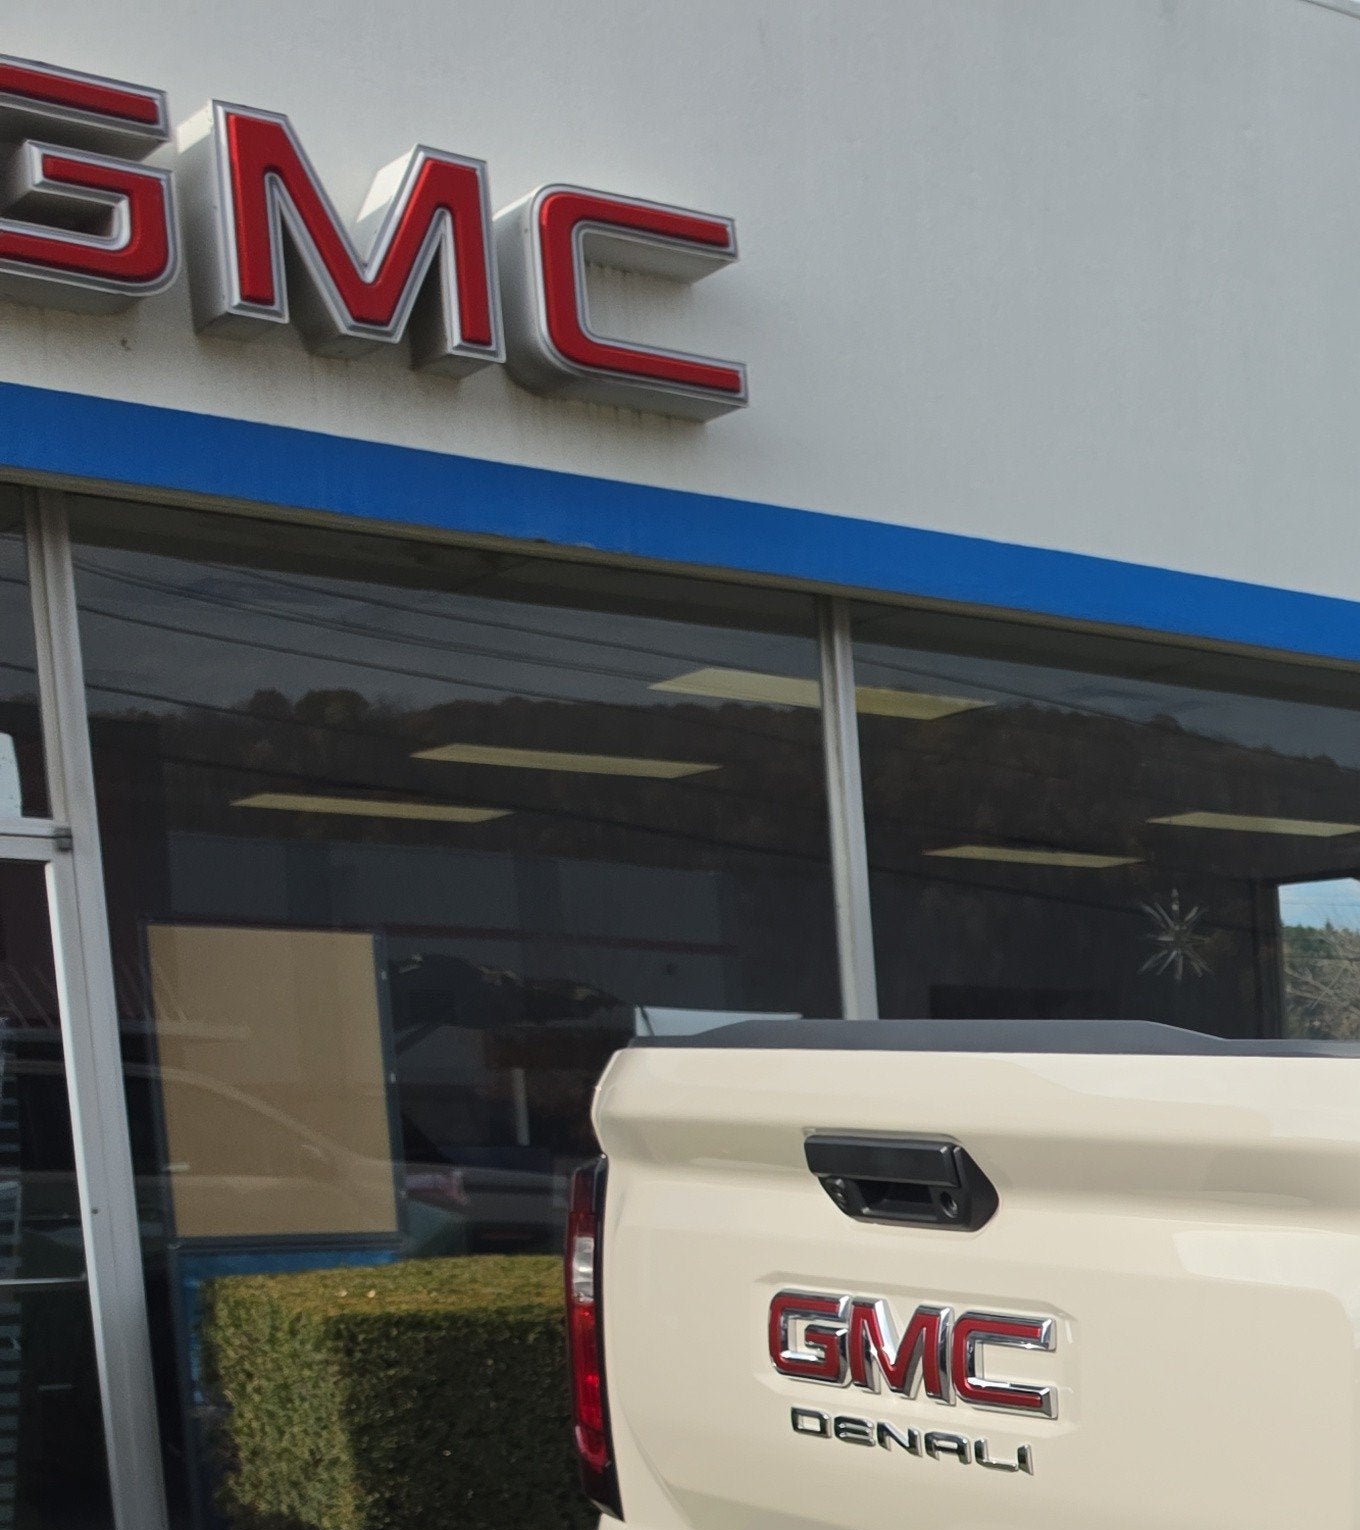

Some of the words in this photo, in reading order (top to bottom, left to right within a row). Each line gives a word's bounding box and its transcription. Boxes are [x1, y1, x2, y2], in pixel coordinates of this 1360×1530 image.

[0, 54, 749, 412] GMC
[768, 1289, 1058, 1420] GMC
[790, 1406, 1034, 1475] DENALI
